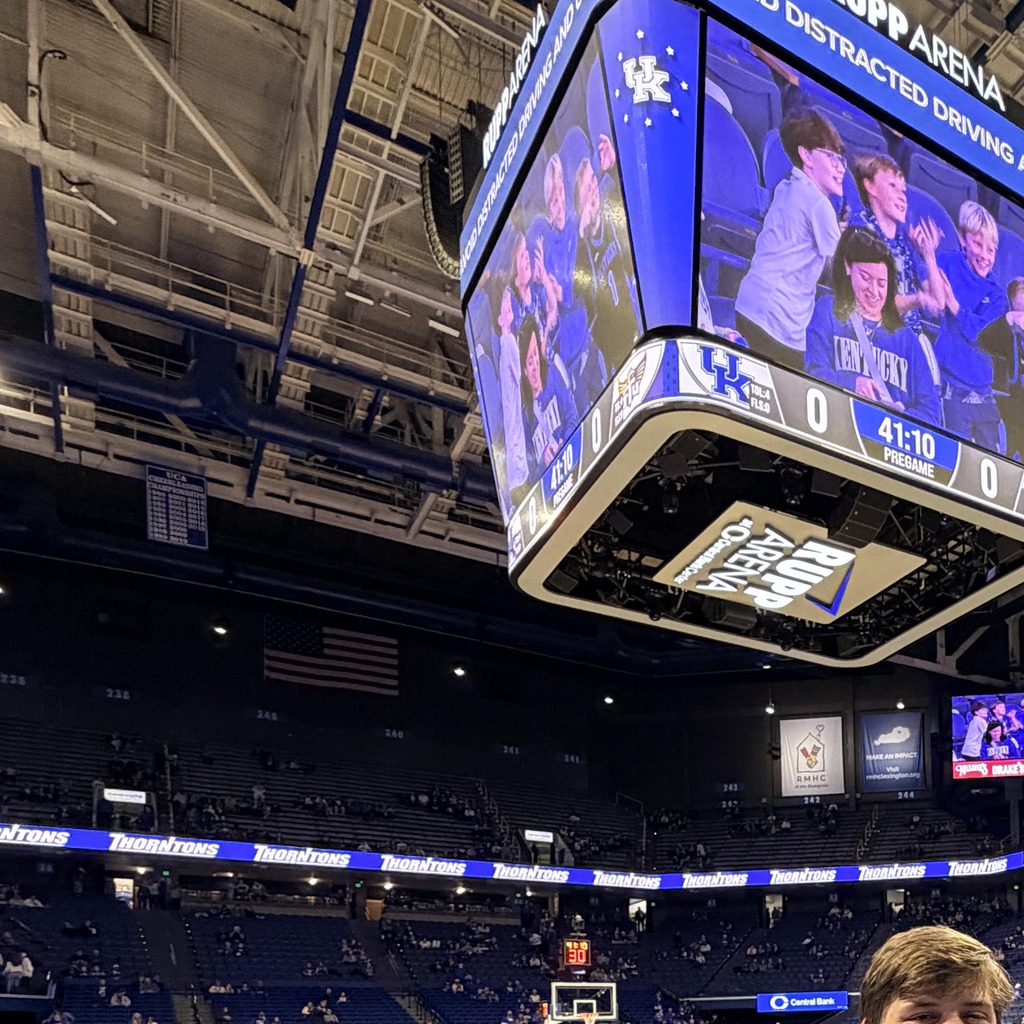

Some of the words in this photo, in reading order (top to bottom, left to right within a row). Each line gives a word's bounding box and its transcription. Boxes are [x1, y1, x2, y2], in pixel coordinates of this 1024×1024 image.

[833, 0, 908, 41] UPP
[908, 25, 1006, 111] ARENA
[483, 87, 509, 169] RUPP
[508, 3, 545, 109] ARENA
[519, 52, 552, 141] DRIVING
[553, 3, 574, 64] AND
[785, 4, 928, 107] DISTRACTED
[933, 96, 1014, 164] DRIVING
[806, 388, 828, 433] 0
[592, 408, 601, 452] 0
[878, 417, 935, 460] 41:10
[550, 443, 573, 491] 41:10
[884, 446, 935, 479] PREGAME
[980, 458, 998, 499] 0
[528, 496, 537, 535] 0
[695, 527, 796, 593] ARENA
[744, 540, 857, 609] RUPP
[796, 775, 827, 783] RMHC
[0, 824, 70, 847] NTONS
[109, 833, 219, 859] THORNTONS
[254, 844, 350, 868] THORNTONS
[380, 854, 466, 876] THORNTONS
[948, 857, 1007, 876] THORNTONS
[493, 862, 570, 884] THORNTONS
[593, 870, 662, 889] THORNTONS
[682, 871, 748, 889] THORNTONS
[769, 868, 836, 886] THORNTONS
[858, 864, 926, 882] THORNTONS
[568, 949, 586, 963] 30
[790, 997, 815, 1007] Central
[816, 997, 835, 1006] Bank
